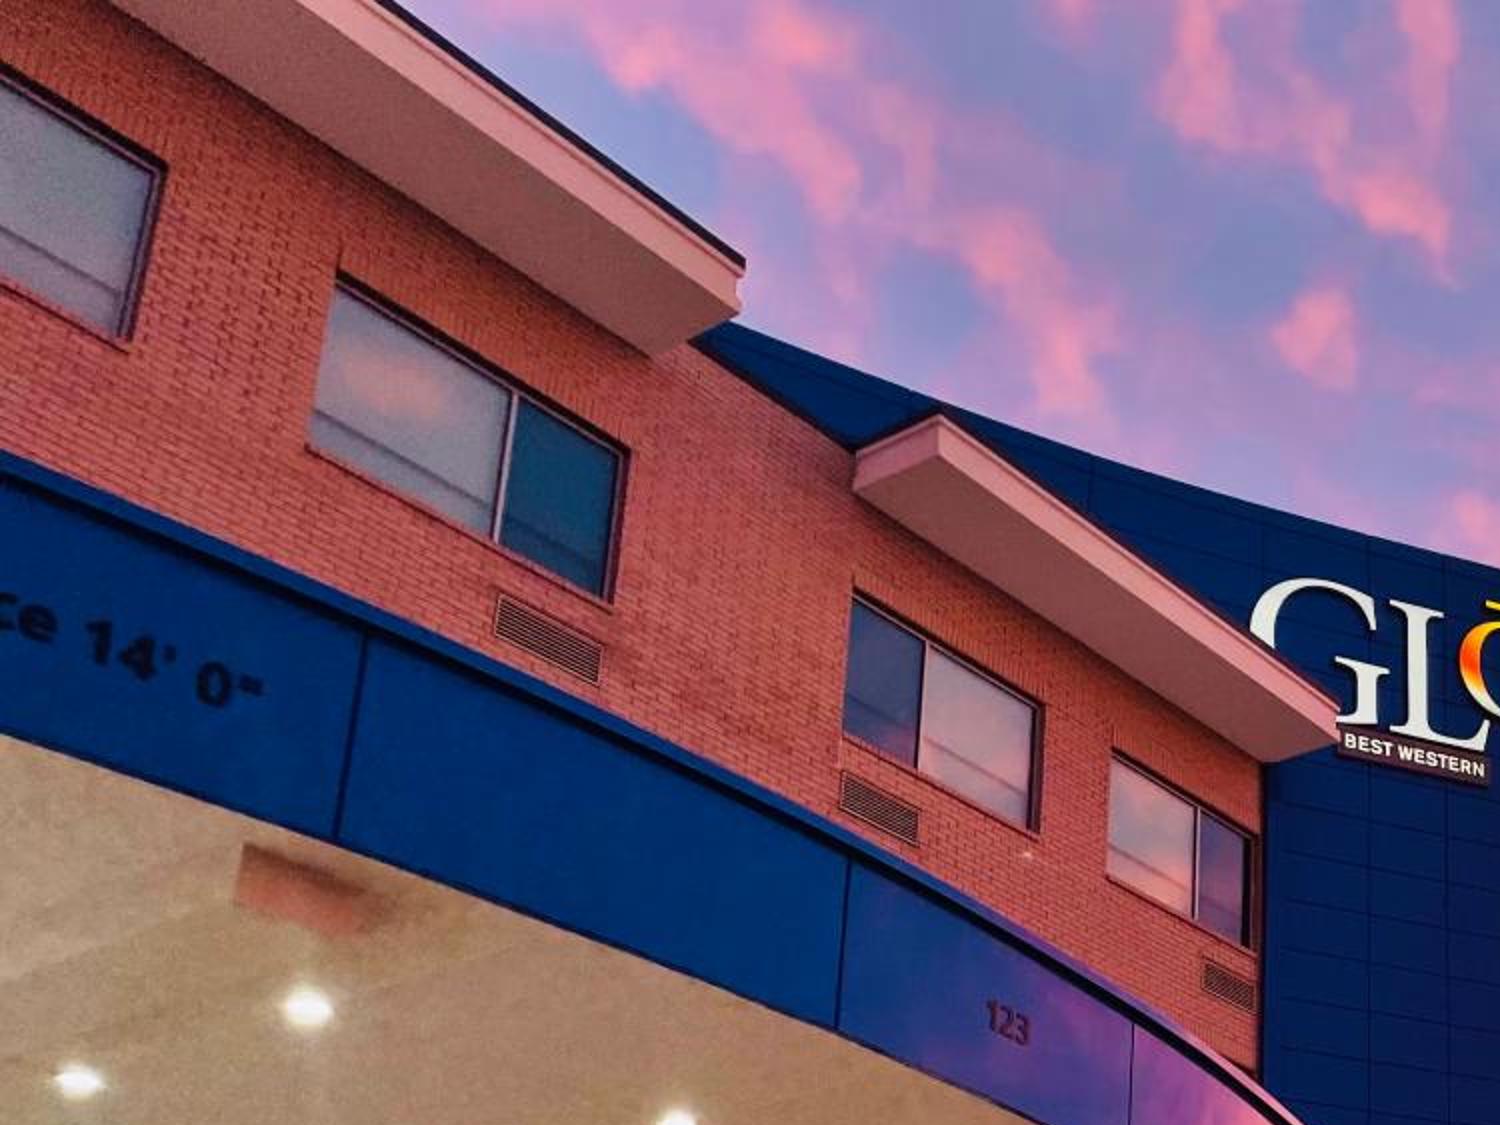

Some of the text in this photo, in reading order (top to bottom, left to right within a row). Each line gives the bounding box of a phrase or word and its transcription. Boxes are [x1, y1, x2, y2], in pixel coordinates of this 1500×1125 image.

[1344, 733, 1486, 777] BEST WESTERN
[986, 998, 1029, 1047] 123
